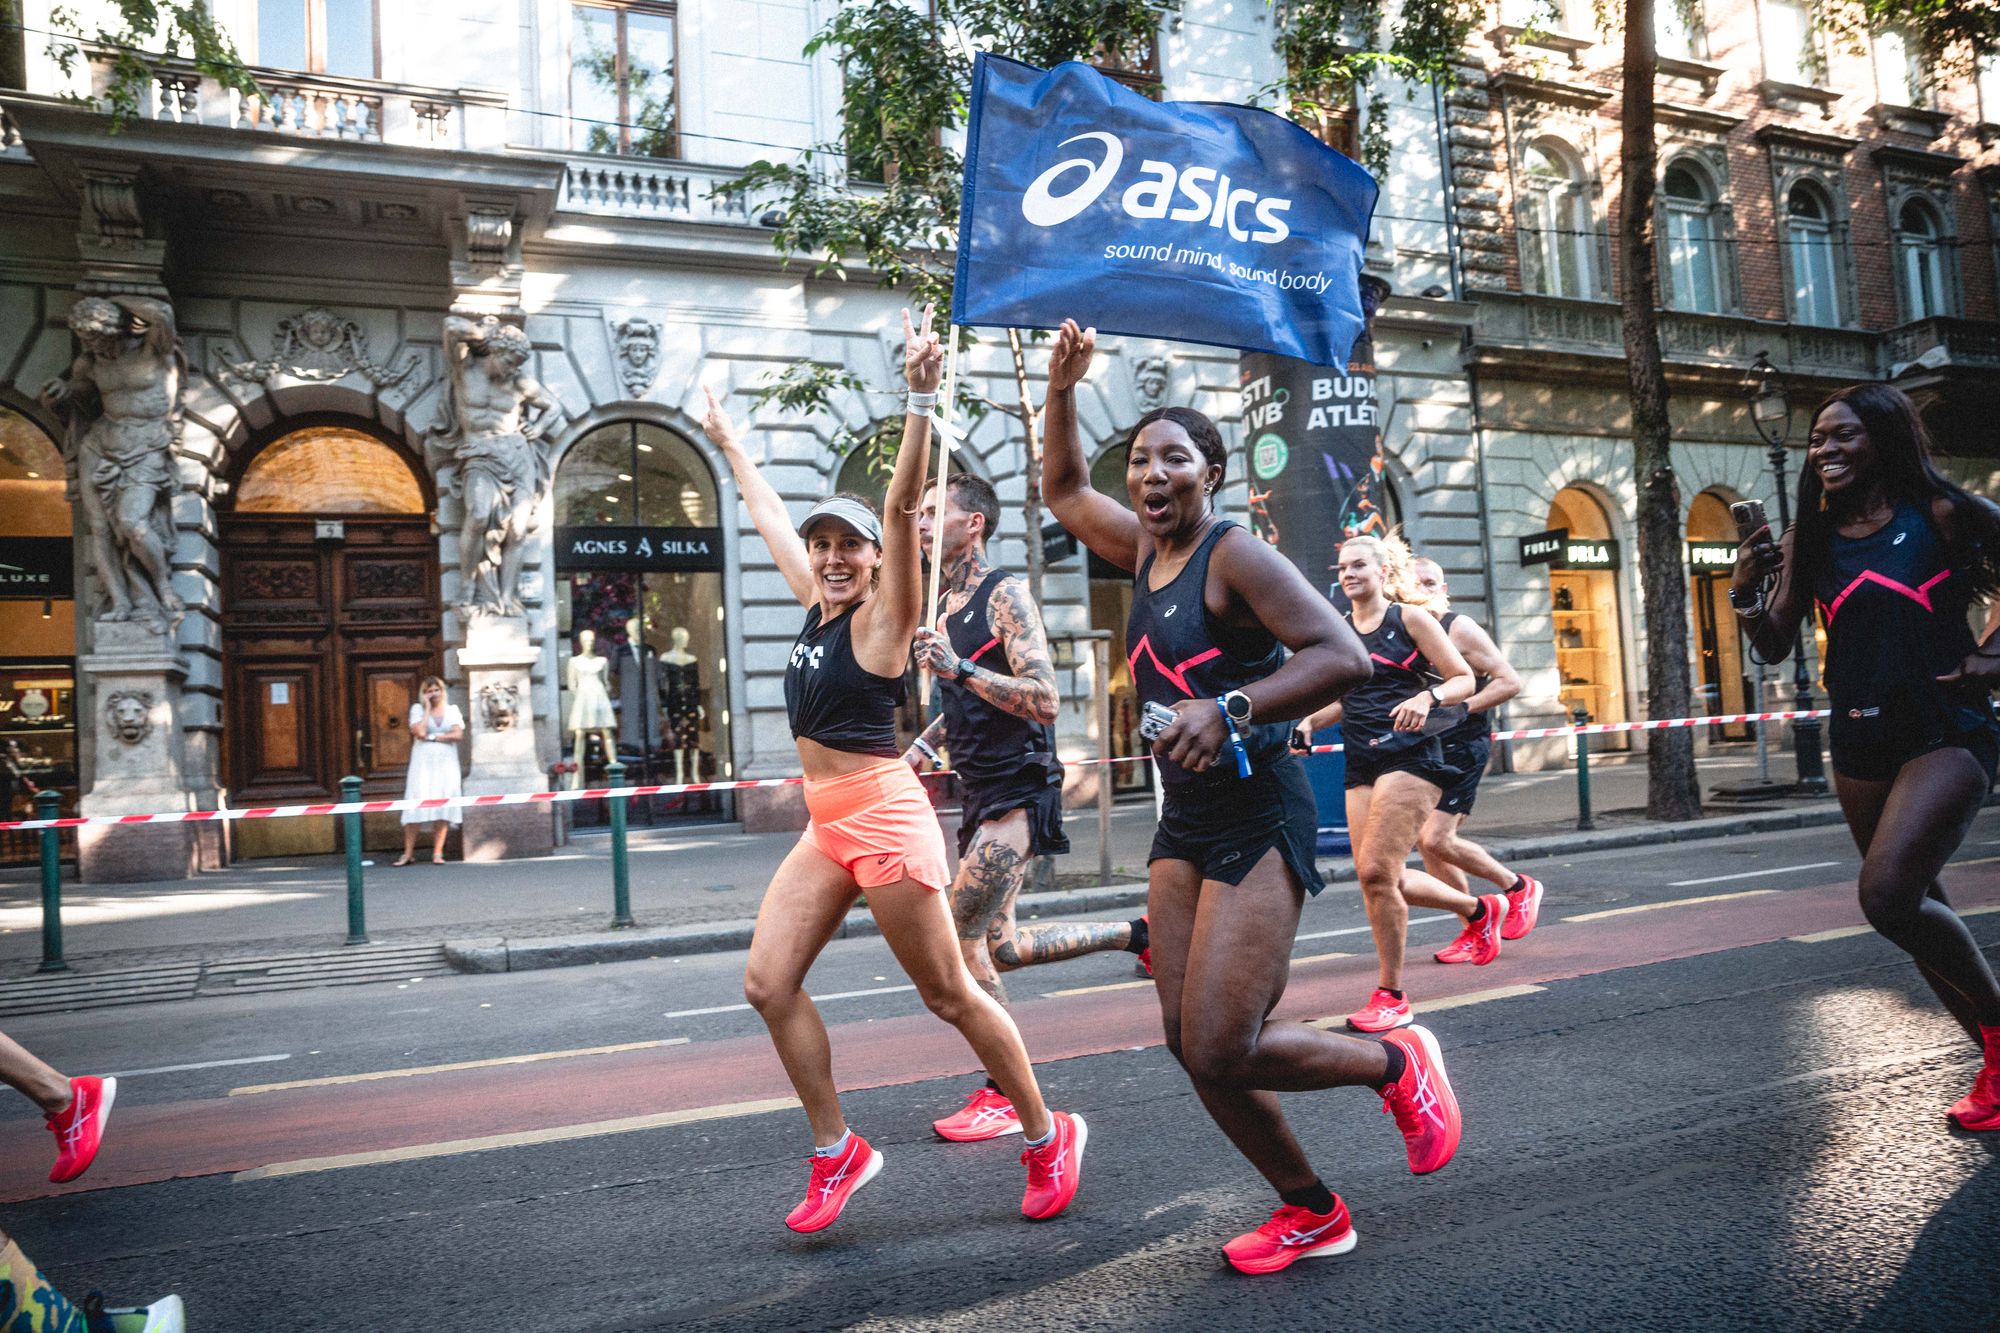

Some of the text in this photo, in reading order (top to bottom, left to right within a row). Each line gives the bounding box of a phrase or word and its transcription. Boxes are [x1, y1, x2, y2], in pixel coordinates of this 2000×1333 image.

[1122, 160, 1292, 244] asics
[1103, 243, 1333, 295] sound mind, sound body
[572, 540, 627, 554] AGNES
[661, 541, 709, 554] SILKA
[1523, 539, 1560, 557] FURLA
[1567, 545, 1610, 563] URLA
